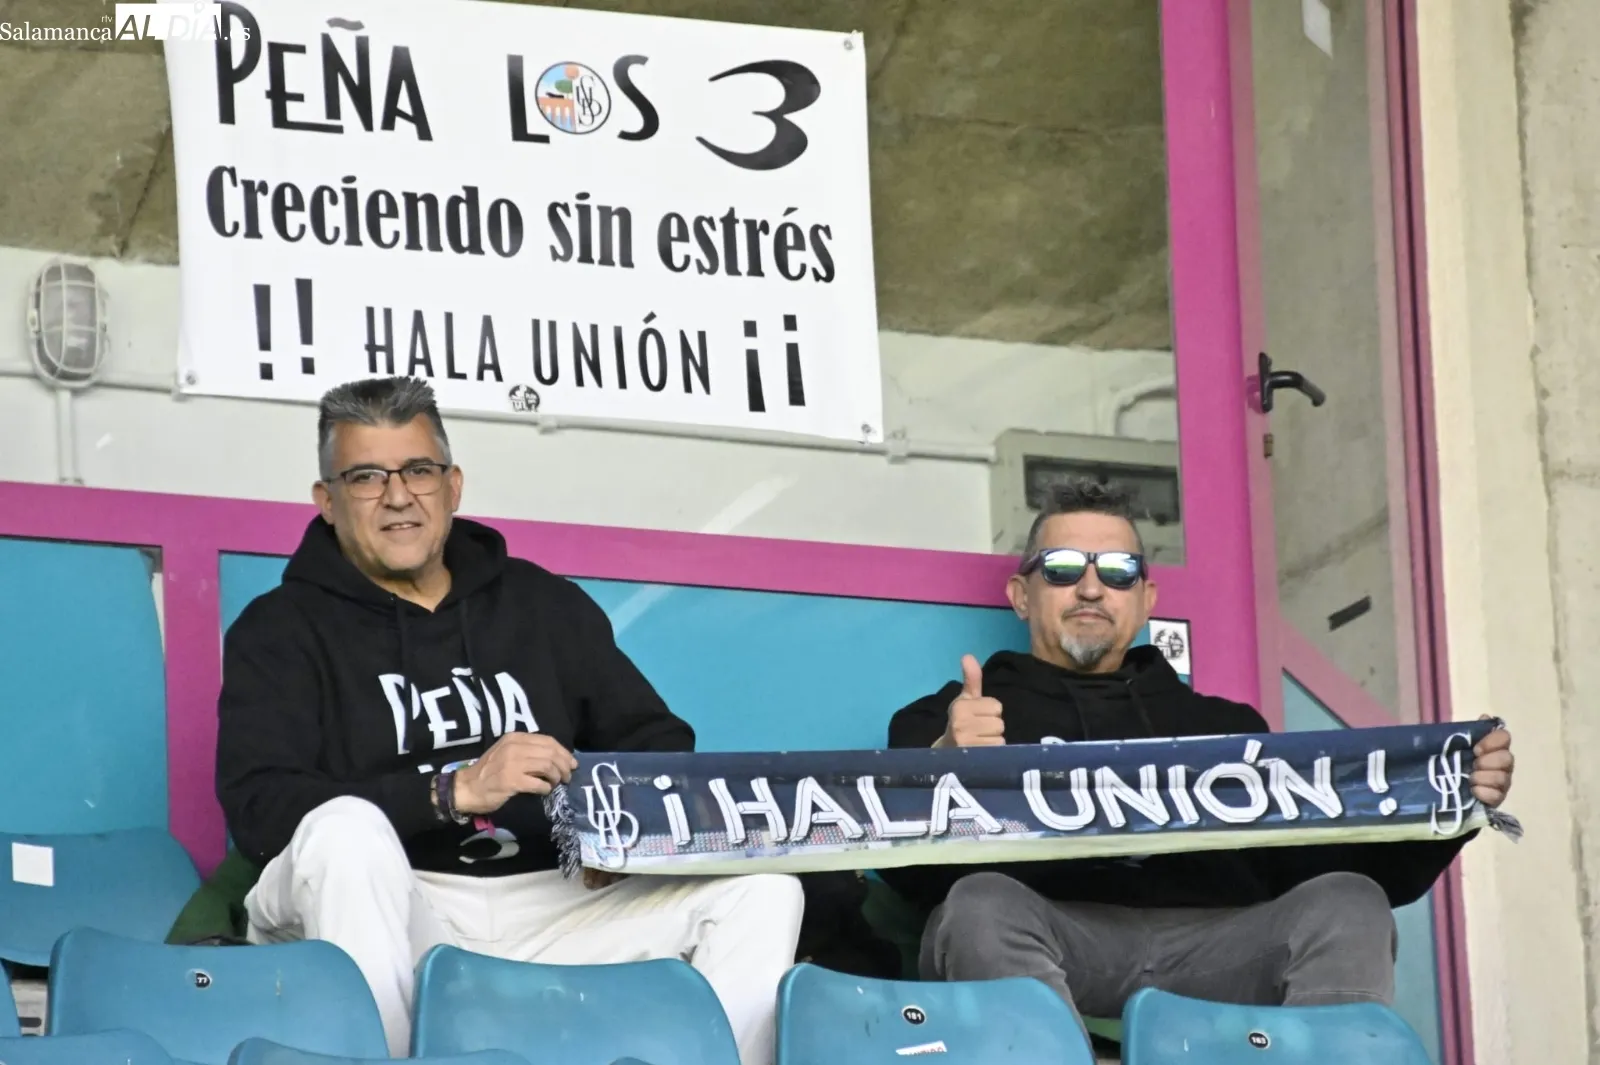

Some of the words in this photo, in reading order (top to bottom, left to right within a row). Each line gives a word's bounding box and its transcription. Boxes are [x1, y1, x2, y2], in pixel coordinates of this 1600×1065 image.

[213, 1, 434, 142] PEÑA
[696, 60, 821, 171] 3
[206, 165, 524, 258] Creciendo
[548, 192, 635, 269] sin
[657, 207, 836, 284] estrés
[364, 306, 503, 382] HALA
[530, 311, 712, 396] UNIÓN
[378, 667, 540, 755] PEÑA
[1022, 739, 1343, 832] UNIÓN
